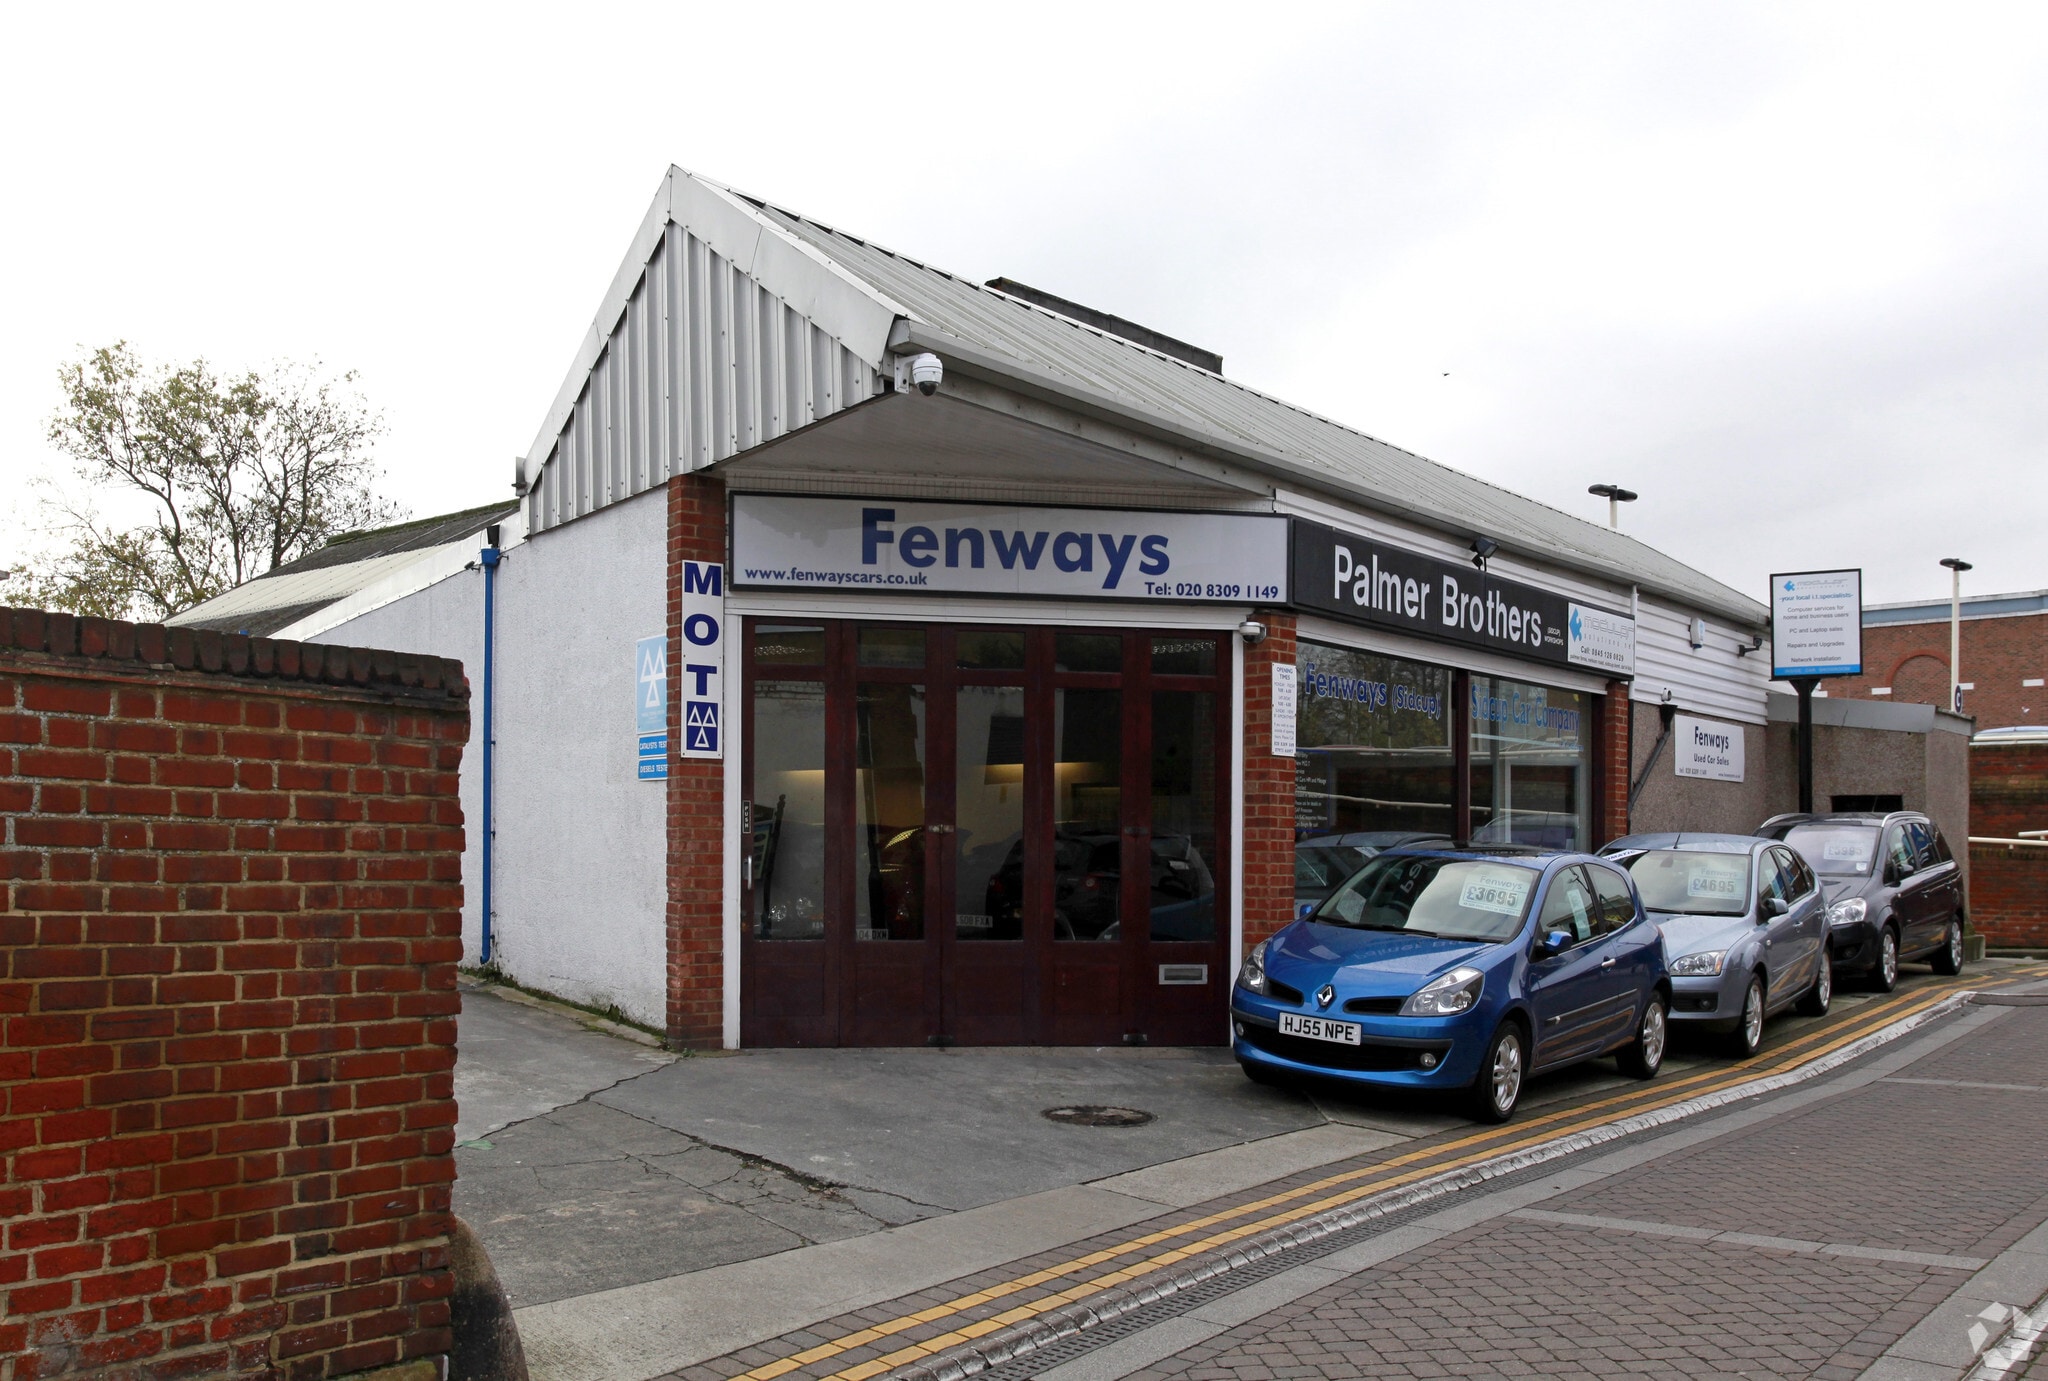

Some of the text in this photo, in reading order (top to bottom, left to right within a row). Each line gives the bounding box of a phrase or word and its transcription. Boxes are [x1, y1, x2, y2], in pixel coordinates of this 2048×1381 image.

[862, 507, 1170, 589] Fenways
[745, 567, 927, 585] www.fenwayscars.co.uk
[1144, 582, 1278, 598] Tel: 020 8309 1149
[1334, 544, 1542, 647] Palmer Brothers
[684, 562, 721, 696] MOT
[1305, 662, 1440, 720] Fenways (Sidcup)
[1471, 684, 1580, 741] Sidcup Car Company
[1695, 726, 1729, 753] Fenways
[1694, 753, 1729, 766] Used Car Sales
[1480, 876, 1522, 890] Fenways
[1701, 868, 1738, 877] Fenways
[1467, 886, 1517, 907] £3695
[1693, 878, 1735, 893] £4695
[1285, 1016, 1354, 1041] HJ55 NPE
